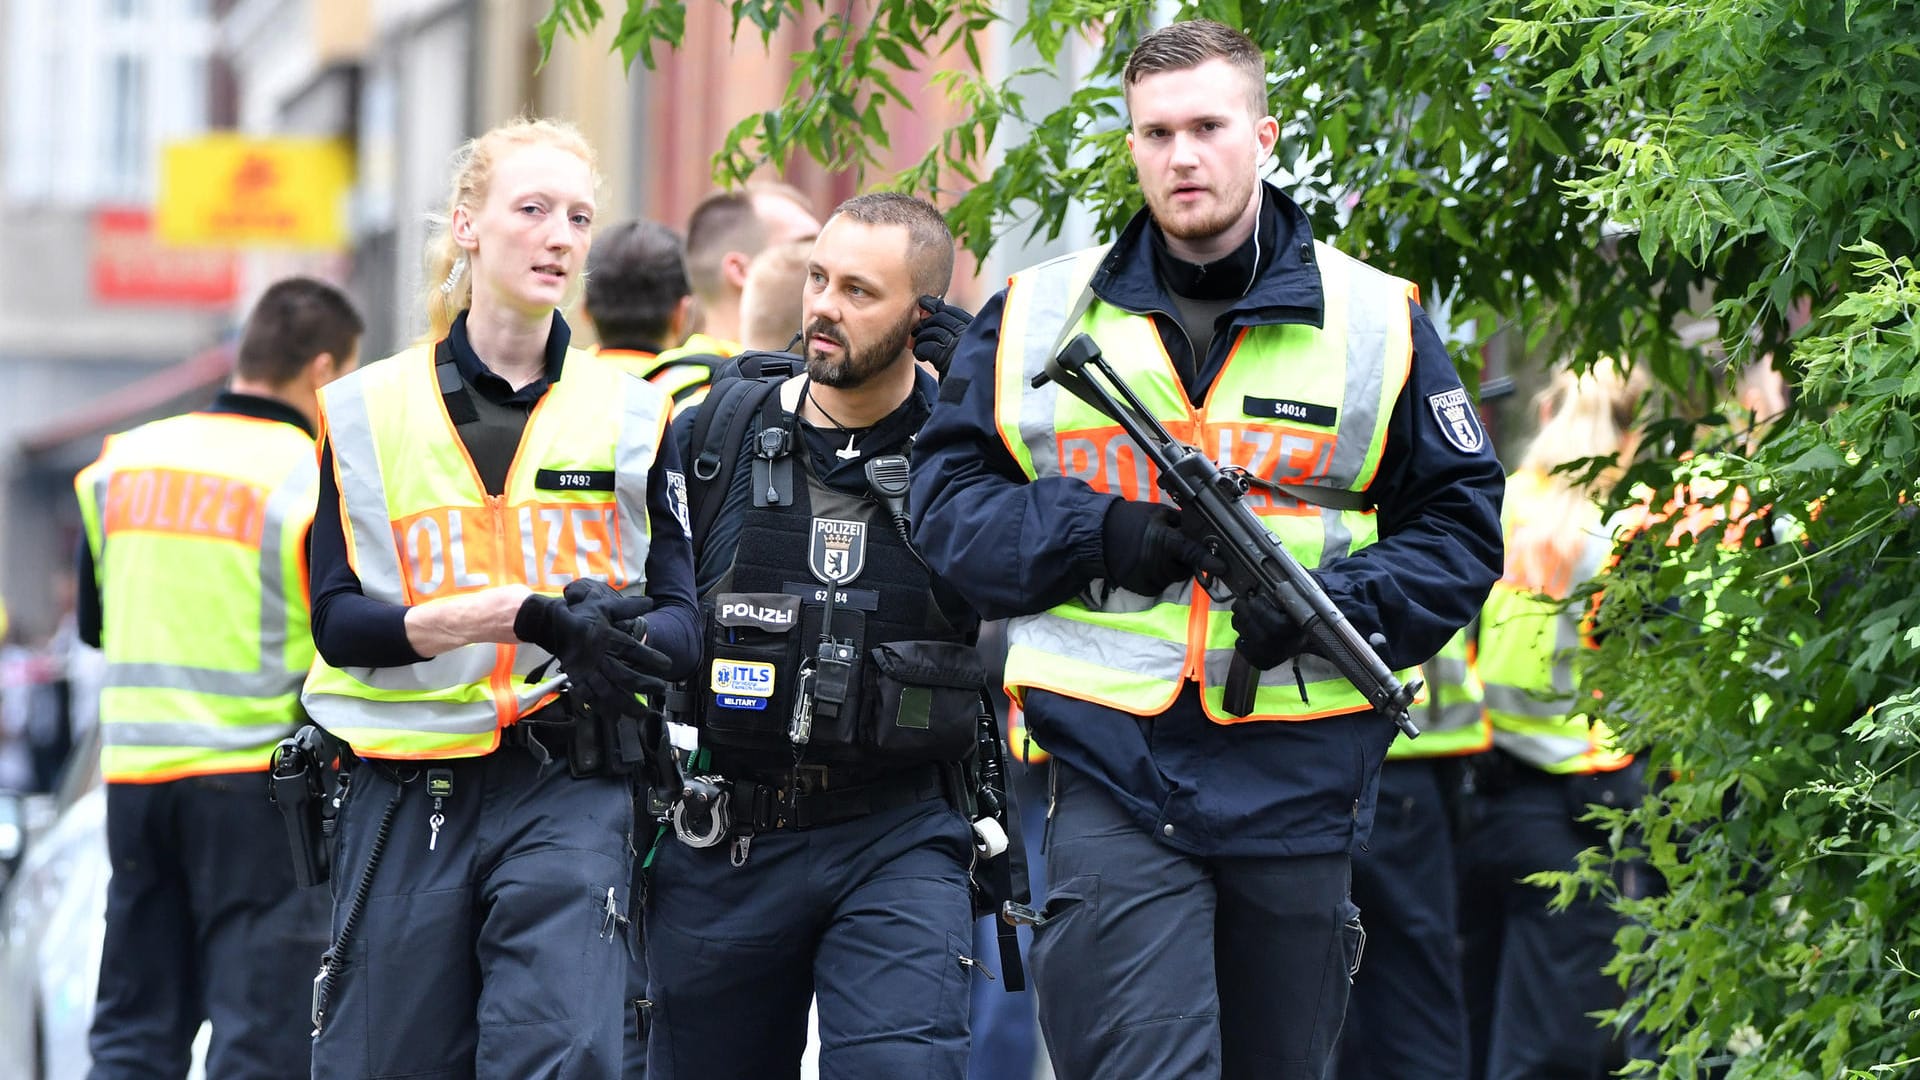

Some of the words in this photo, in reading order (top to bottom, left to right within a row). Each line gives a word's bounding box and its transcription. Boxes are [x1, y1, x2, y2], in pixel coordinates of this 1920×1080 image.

[1433, 393, 1466, 411] POLIZEI
[1275, 403, 1307, 418] 54014
[559, 474, 591, 487] 97492
[817, 521, 860, 536] POLIZEI
[394, 506, 627, 595] OLIZEI
[815, 590, 848, 604] 6284
[733, 666, 769, 682] ITLS
[724, 697, 757, 707] MILITARY
